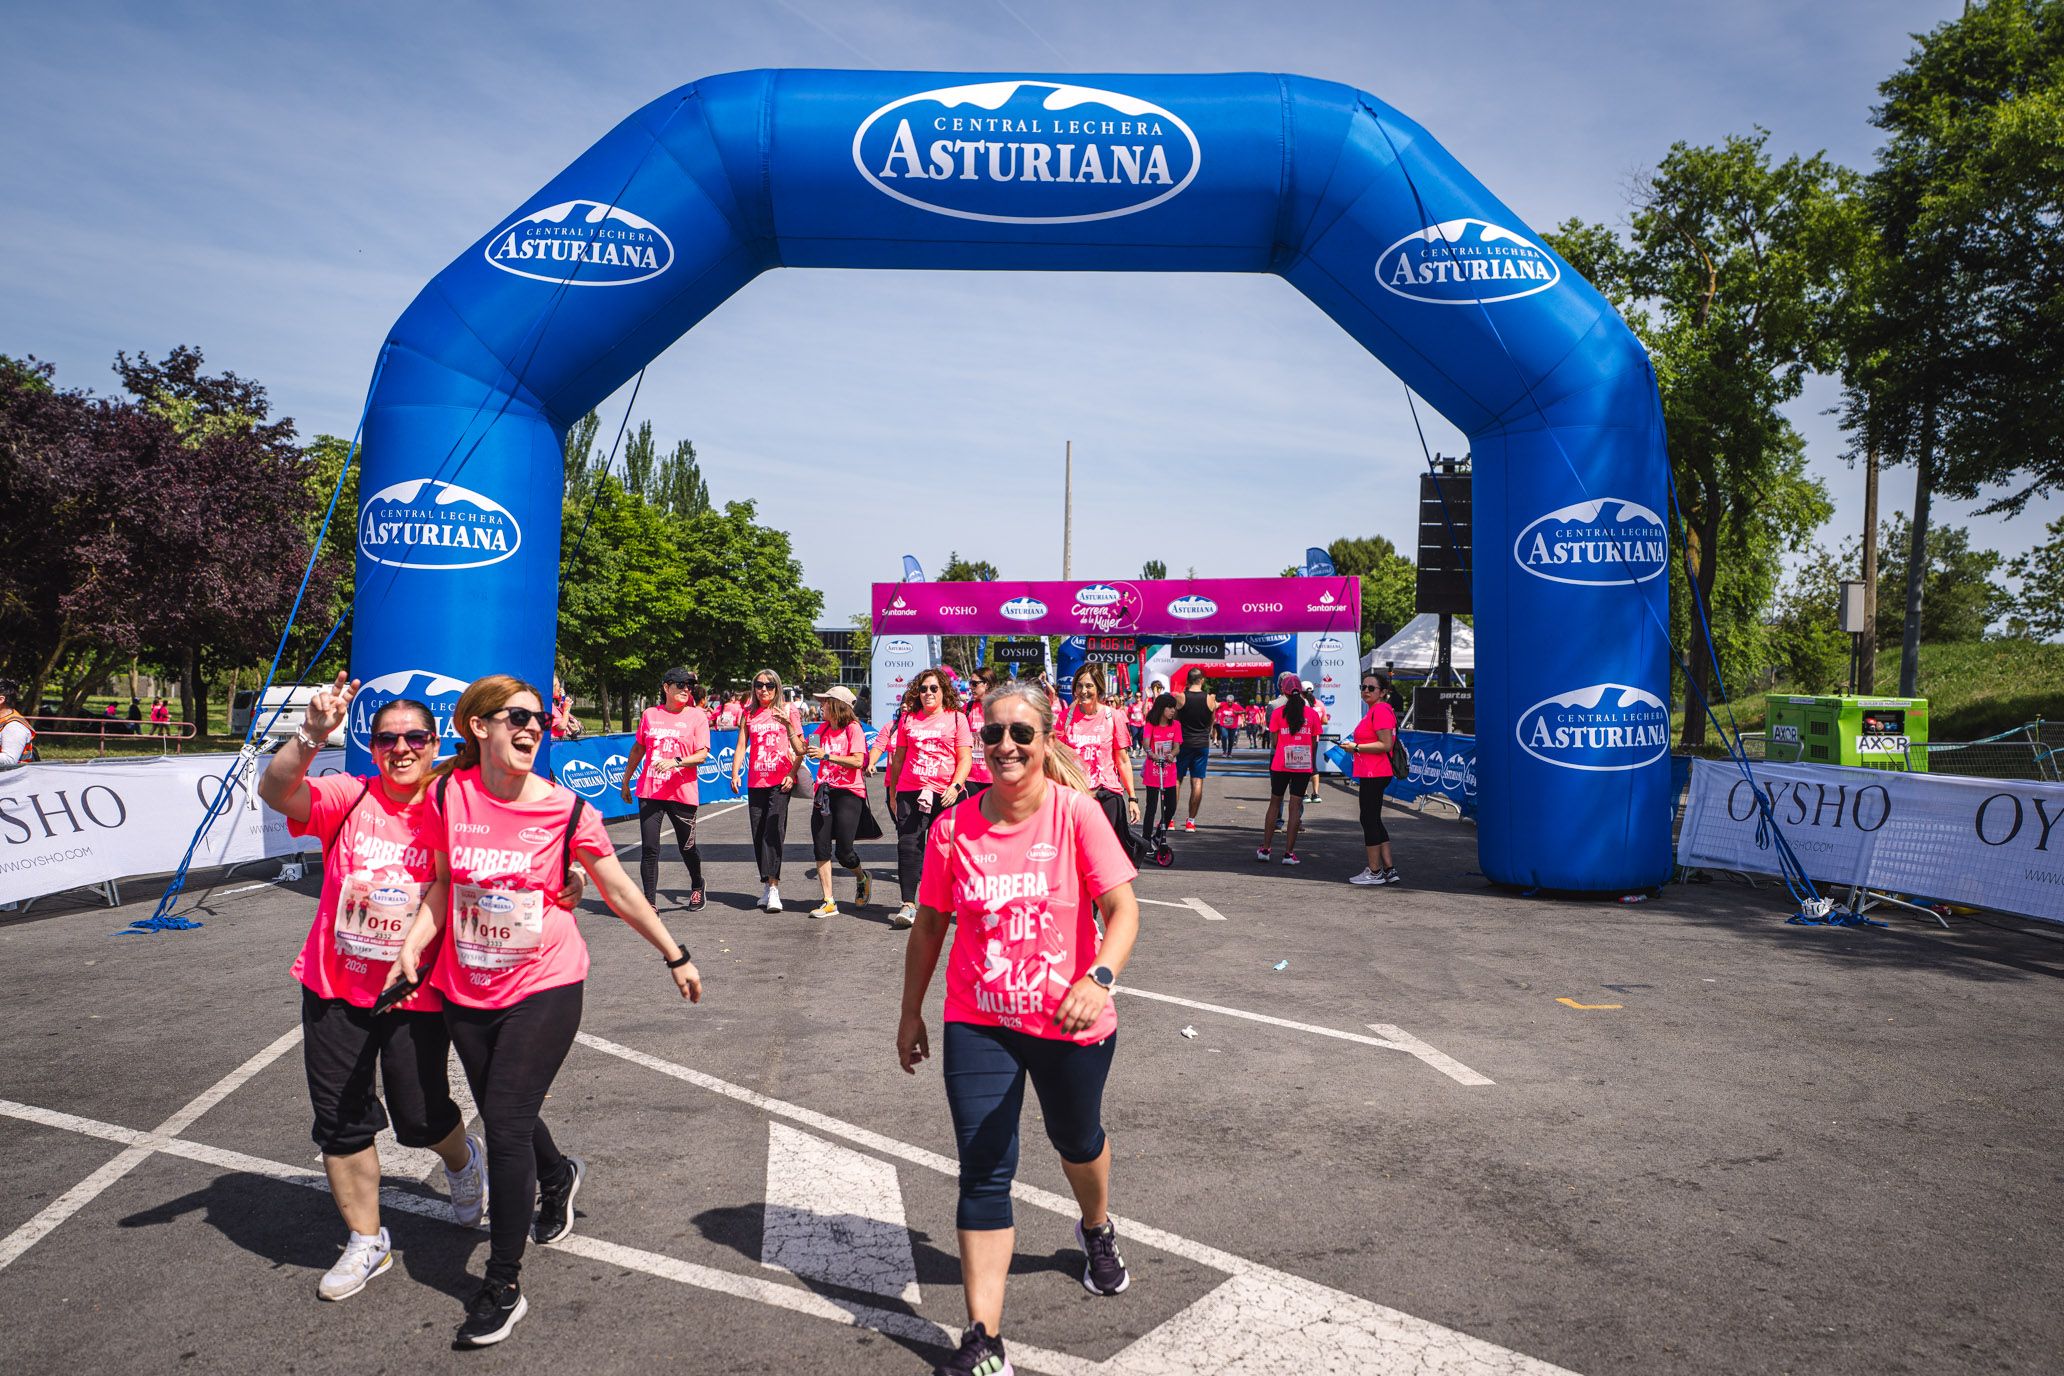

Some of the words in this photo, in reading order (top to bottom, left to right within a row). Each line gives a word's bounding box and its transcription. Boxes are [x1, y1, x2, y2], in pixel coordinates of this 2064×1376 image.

[933, 117, 1042, 133] CENTRAL
[1054, 119, 1163, 135] LECHERA
[879, 118, 1173, 185] ASTURIANA
[526, 228, 584, 237] CENTRAL
[589, 228, 654, 243] LECHERA
[494, 232, 659, 269] ASTURIANA
[1421, 247, 1482, 258] CENTRAL
[1487, 247, 1540, 259] LECHERA
[1390, 252, 1552, 285] ASTURIANA
[380, 509, 435, 519] CENTRAL
[441, 511, 503, 525] LECHERA
[363, 512, 509, 552] ASTURIANA
[1555, 528, 1616, 538] CENTRAL
[1621, 528, 1662, 537] LECHERA
[1527, 532, 1665, 565] ASTURIANA
[1080, 592, 1117, 601] ASTURIANA
[939, 606, 978, 616] OYSHO
[1004, 606, 1044, 615] ASTURIANA
[1071, 604, 1109, 616] Carrera
[1172, 604, 1214, 613] ASTURIANA
[1242, 603, 1284, 613] OYSHO
[1307, 604, 1348, 612] Santander
[1080, 616, 1088, 624] de
[1092, 614, 1122, 633] Mujer
[1001, 648, 1039, 657] OYSHO
[1179, 644, 1218, 654] OYSHO
[884, 660, 914, 668] OYSHO
[1087, 652, 1136, 663] OYSHO
[1311, 659, 1345, 667] OYSHO
[1557, 713, 1618, 723] CENTRAL
[1623, 711, 1664, 721] LECHERA
[1528, 715, 1666, 748] ASTURIANA
[1774, 726, 1797, 742] AXOR
[1858, 736, 1908, 750] AXOR
[1727, 778, 1892, 832] OYSHO
[0, 785, 127, 845] SHO
[454, 823, 490, 834] OYSHO
[354, 831, 428, 870] CARRERA
[0, 846, 94, 874] WW.OYSHO.COM
[450, 846, 533, 874] CARRERA
[964, 871, 1050, 902] CARRERA
[367, 916, 402, 932] 016
[1009, 905, 1037, 941] DE
[480, 924, 511, 940] 016
[345, 958, 368, 975] 2026
[1005, 960, 1029, 991] LA
[976, 983, 1044, 1015] MUJER
